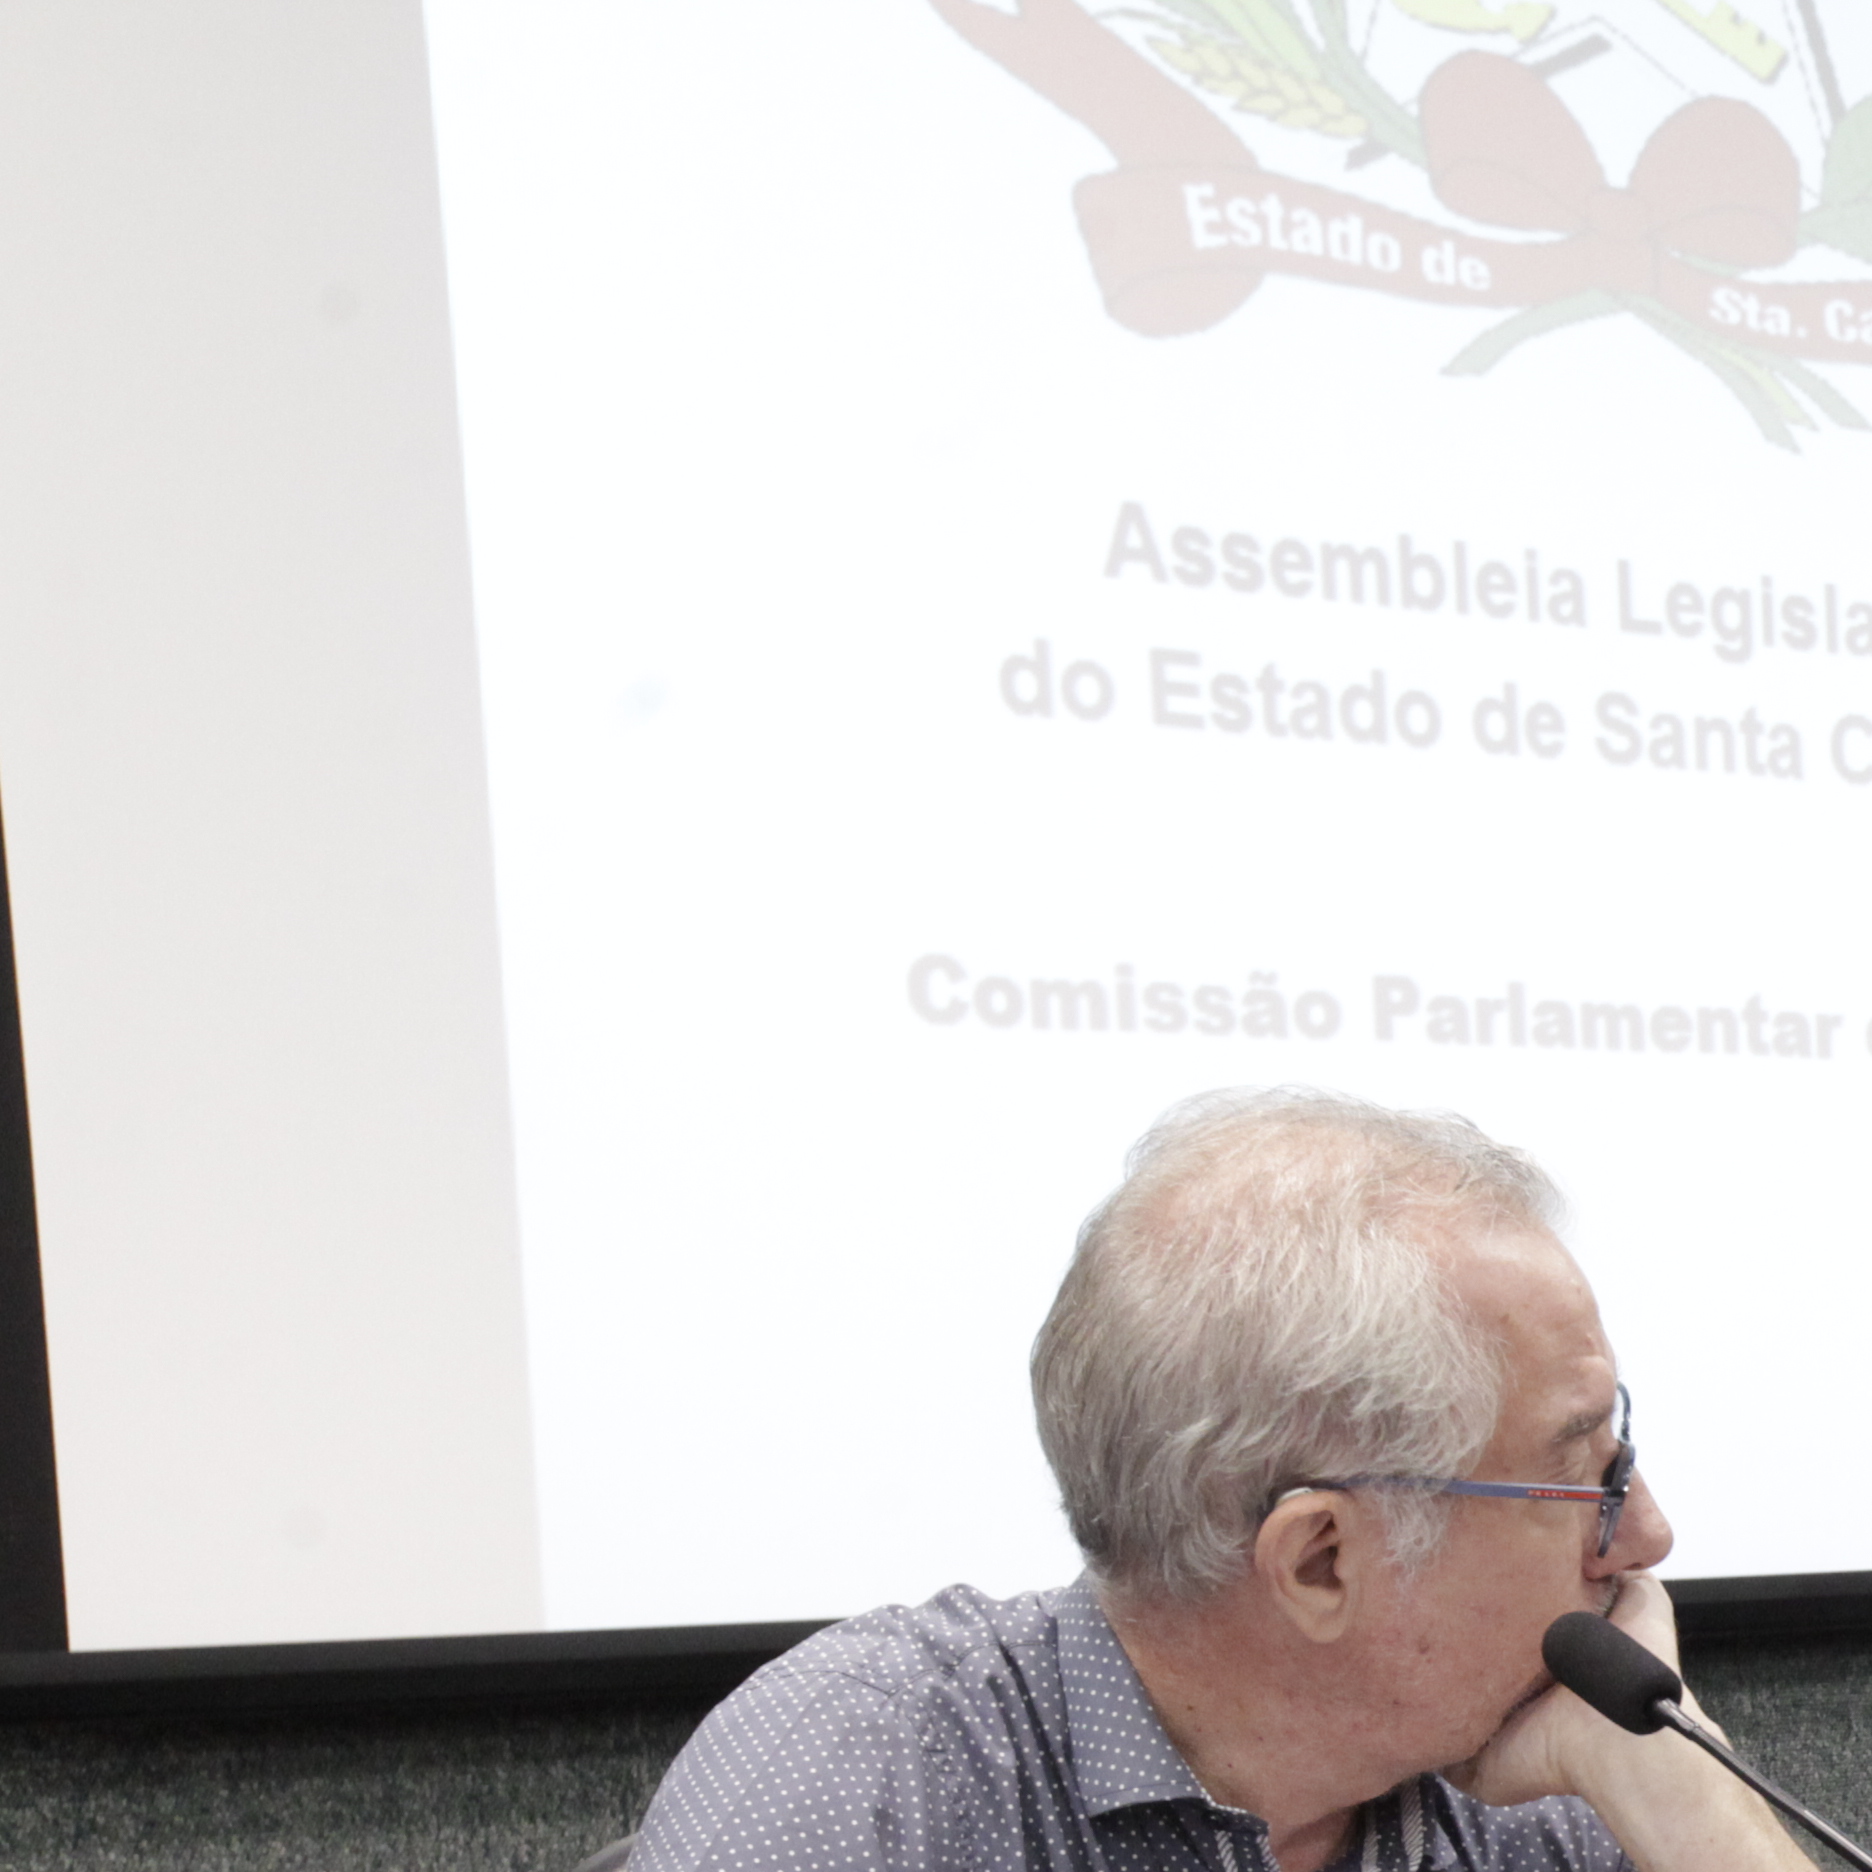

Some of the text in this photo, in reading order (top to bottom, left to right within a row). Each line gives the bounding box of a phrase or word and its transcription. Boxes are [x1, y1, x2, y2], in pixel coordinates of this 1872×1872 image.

[1182, 181, 1493, 292] Estado de
[1105, 502, 1585, 626] Assembleia
[1000, 639, 1114, 720] do
[1150, 649, 1441, 747] Estado
[1474, 683, 1564, 757] de
[1596, 692, 1802, 779] Santa
[906, 953, 1340, 1038] Comissão
[1374, 976, 1841, 1057] Parlamentar
